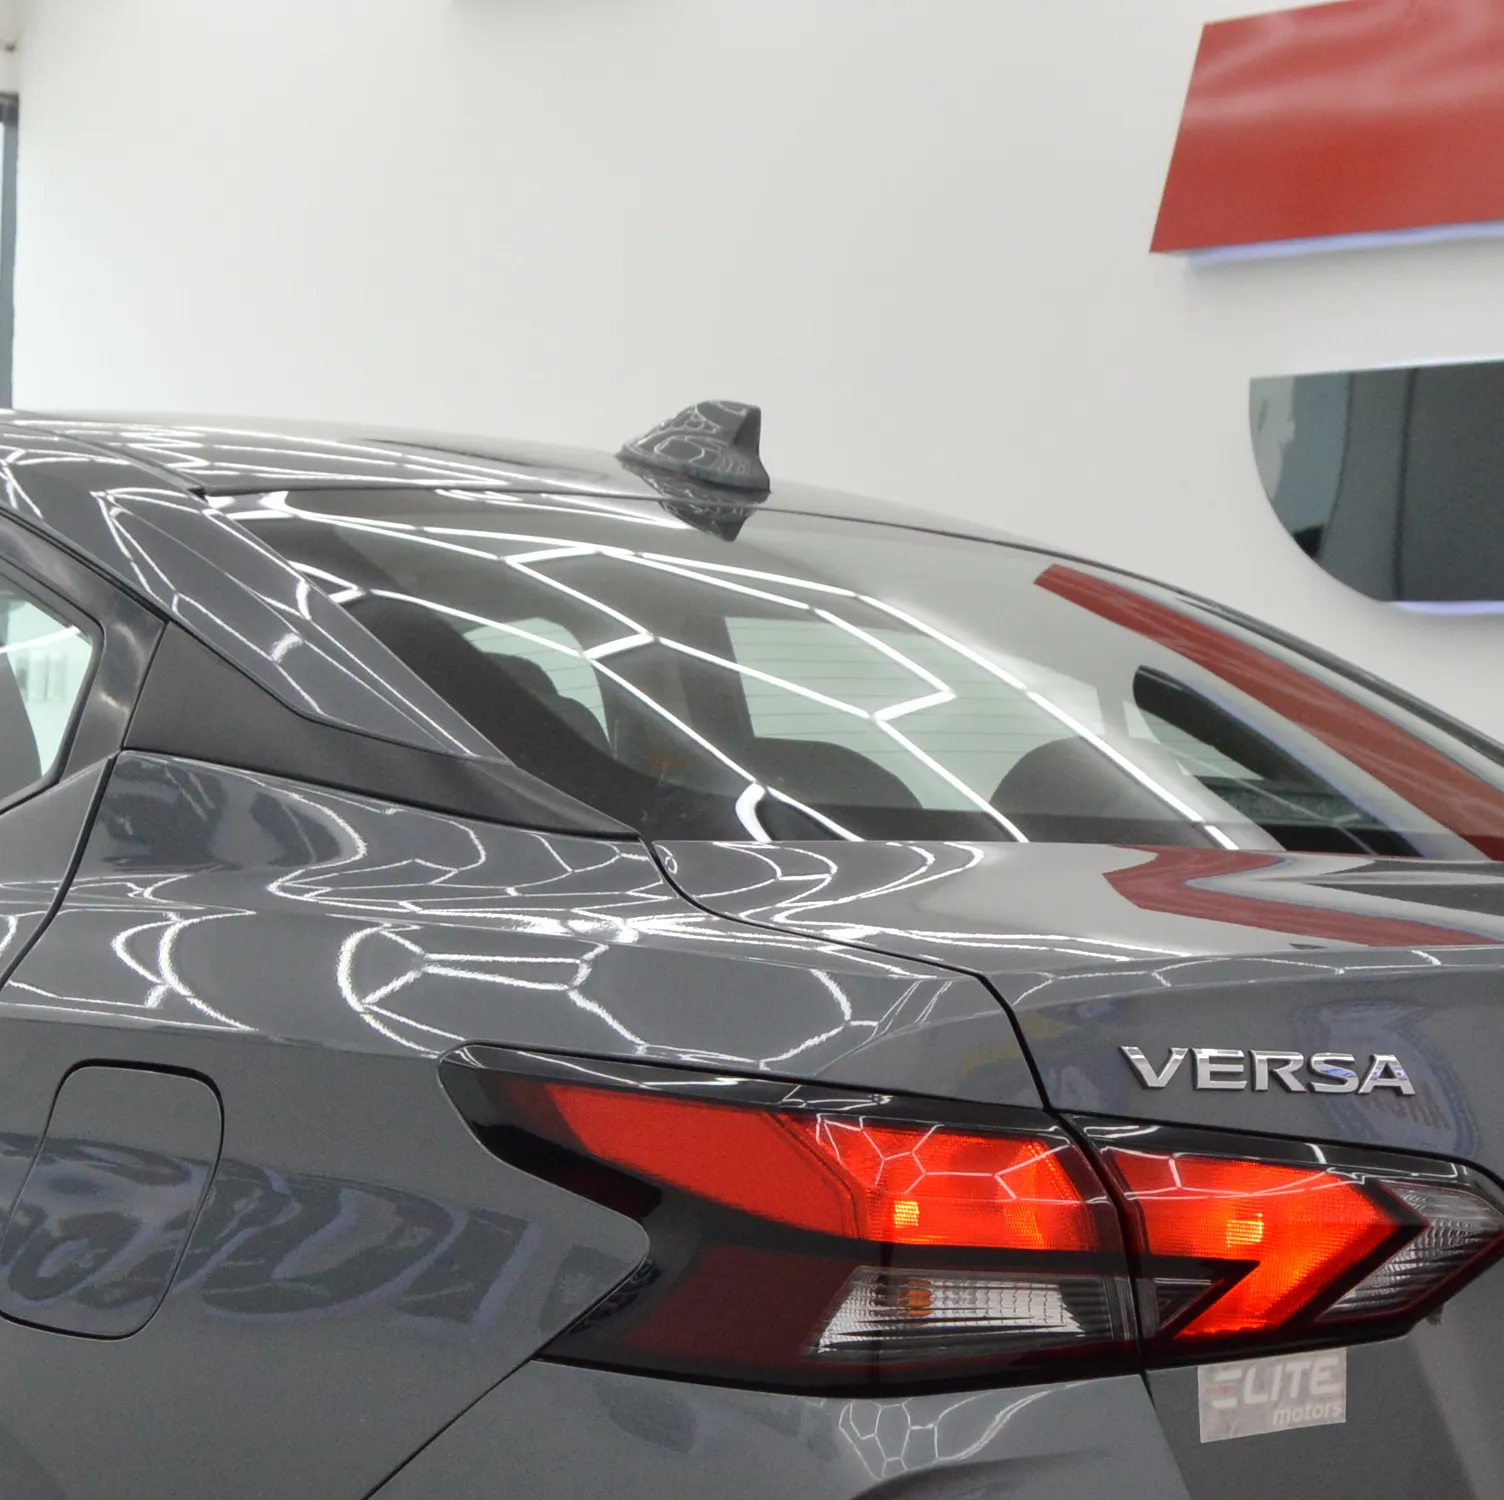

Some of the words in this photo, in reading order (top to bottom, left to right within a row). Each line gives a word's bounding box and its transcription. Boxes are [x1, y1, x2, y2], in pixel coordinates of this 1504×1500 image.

[1120, 1045, 1417, 1096] VERSA
[1206, 1357, 1343, 1409] ELITE
[1272, 1401, 1341, 1425] motors
